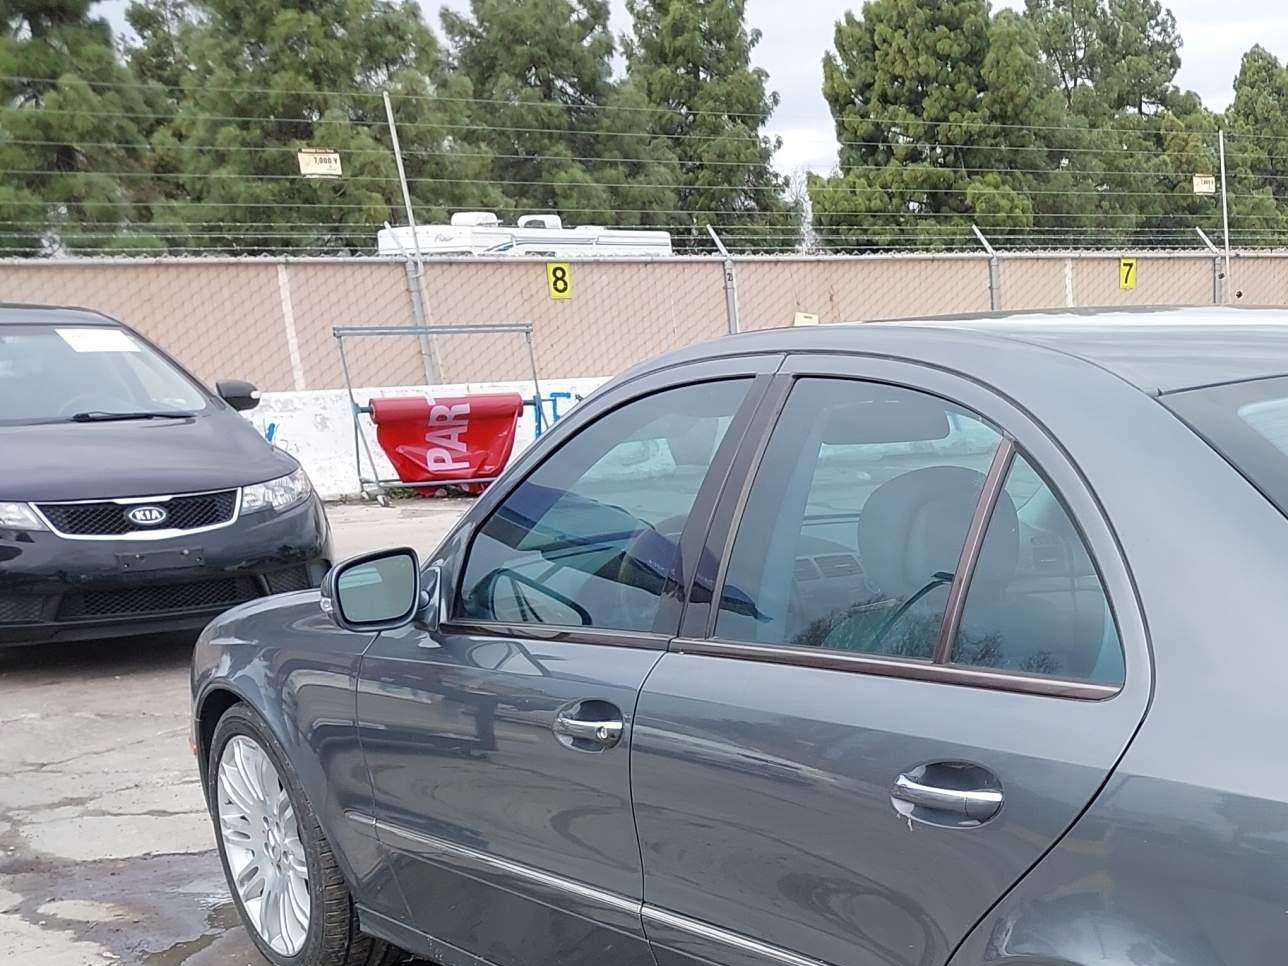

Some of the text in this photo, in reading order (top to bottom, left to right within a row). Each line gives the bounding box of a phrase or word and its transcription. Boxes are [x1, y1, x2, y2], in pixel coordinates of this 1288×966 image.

[552, 266, 568, 293] 8
[1123, 263, 1133, 284] 7
[134, 509, 161, 521] KIA
